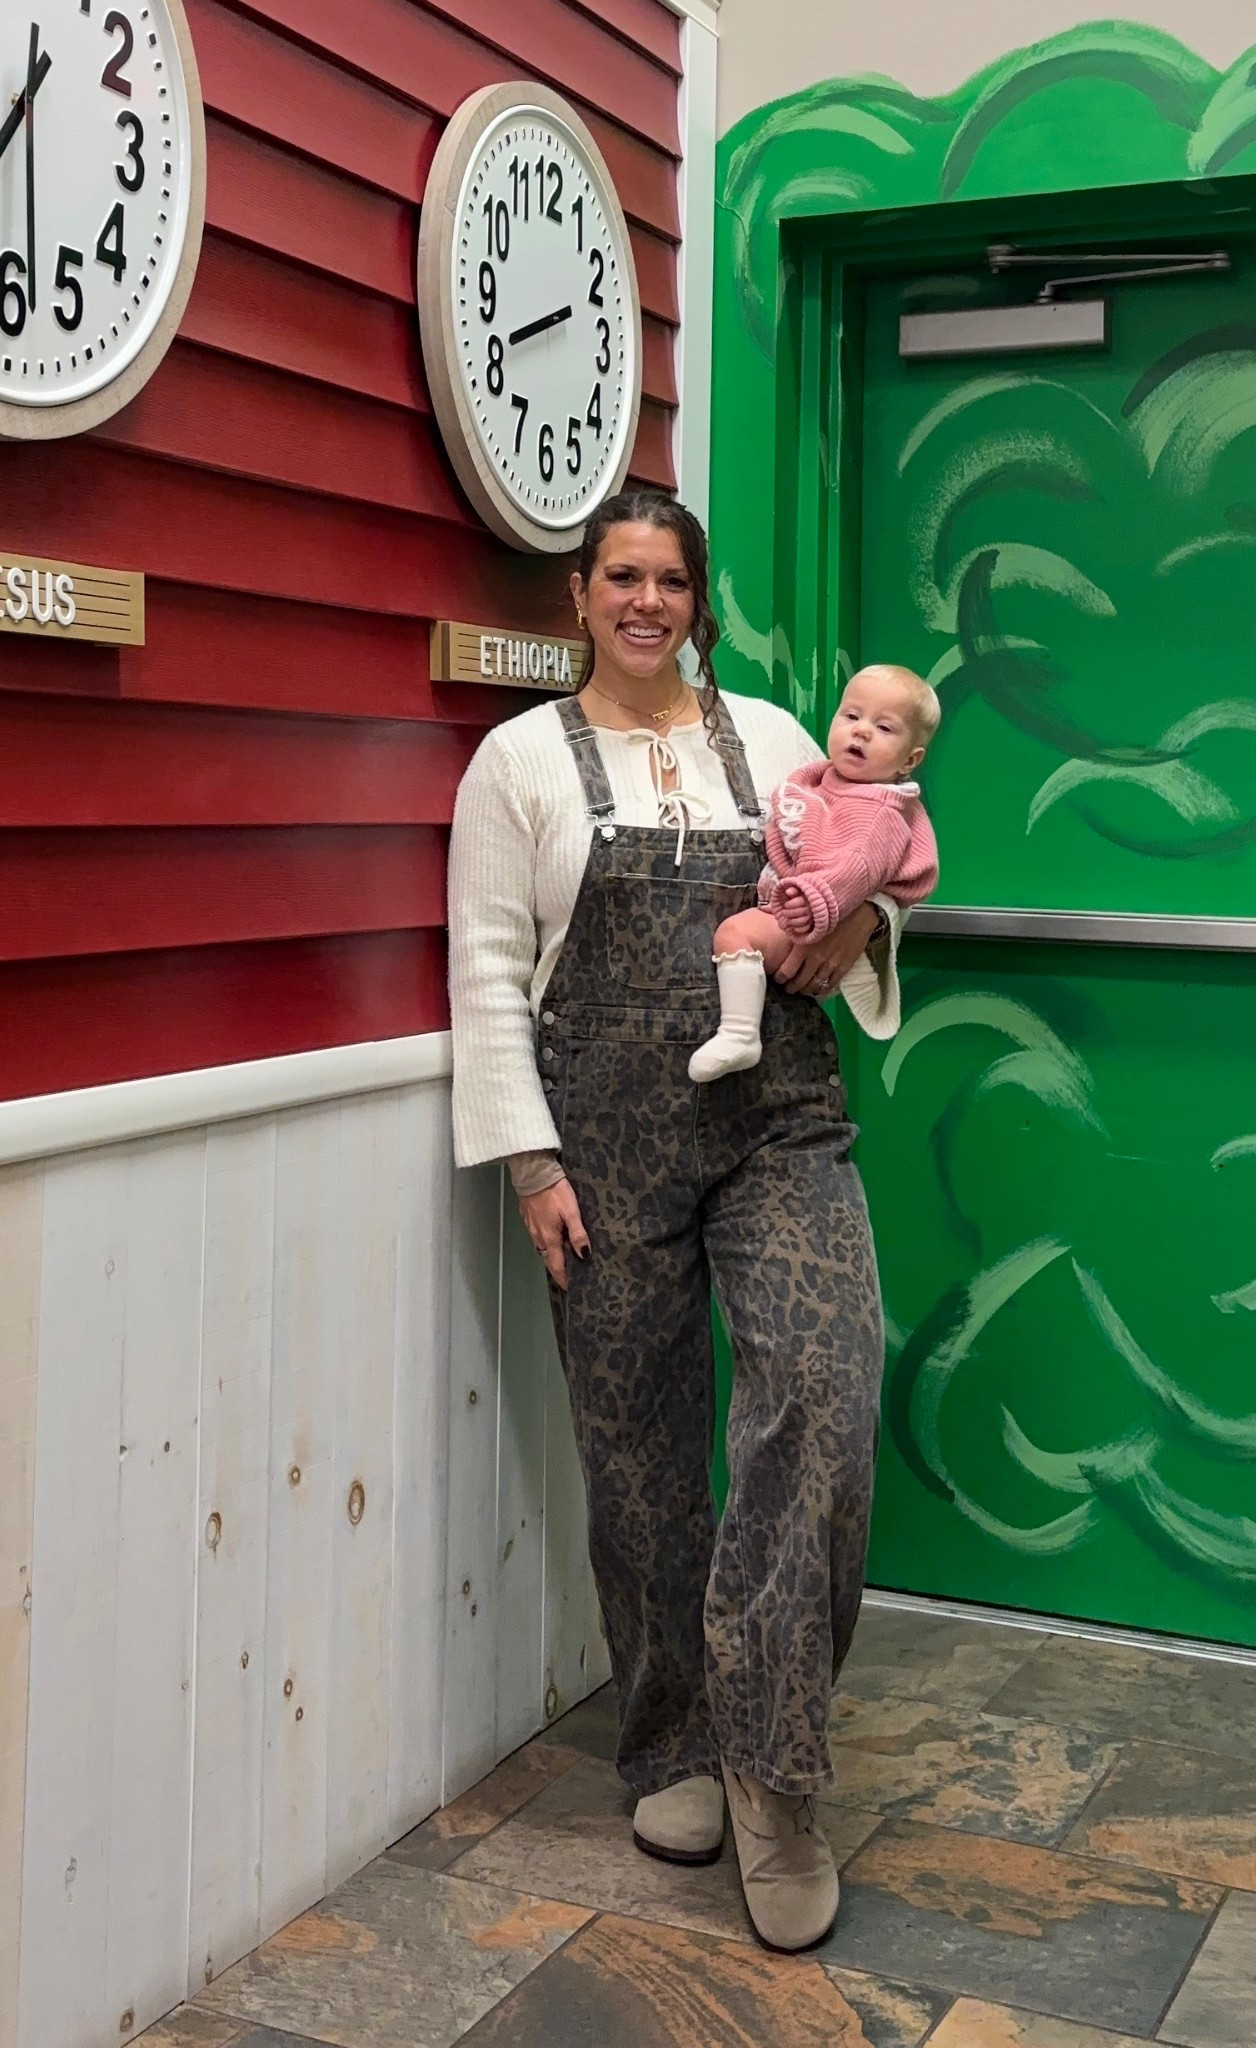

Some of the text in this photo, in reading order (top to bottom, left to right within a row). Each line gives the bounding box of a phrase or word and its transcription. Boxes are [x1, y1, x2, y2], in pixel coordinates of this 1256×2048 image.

[101, 10, 134, 98] 2
[115, 110, 145, 193] 3
[508, 155, 529, 222] 11
[535, 154, 564, 224] 12
[95, 202, 127, 283] 4
[483, 194, 510, 262] 10
[571, 194, 583, 253] 1
[0, 250, 27, 338] 6
[53, 245, 84, 332] 5
[478, 260, 497, 324] 9
[588, 247, 604, 308] 2
[486, 334, 504, 397] 8
[595, 317, 611, 375] 3
[511, 393, 529, 455] 7
[586, 382, 603, 440] 4
[538, 423, 555, 483] 6
[566, 416, 582, 476] 5
[0, 565, 76, 626] SUS
[480, 635, 573, 684] ETHIOPIA
